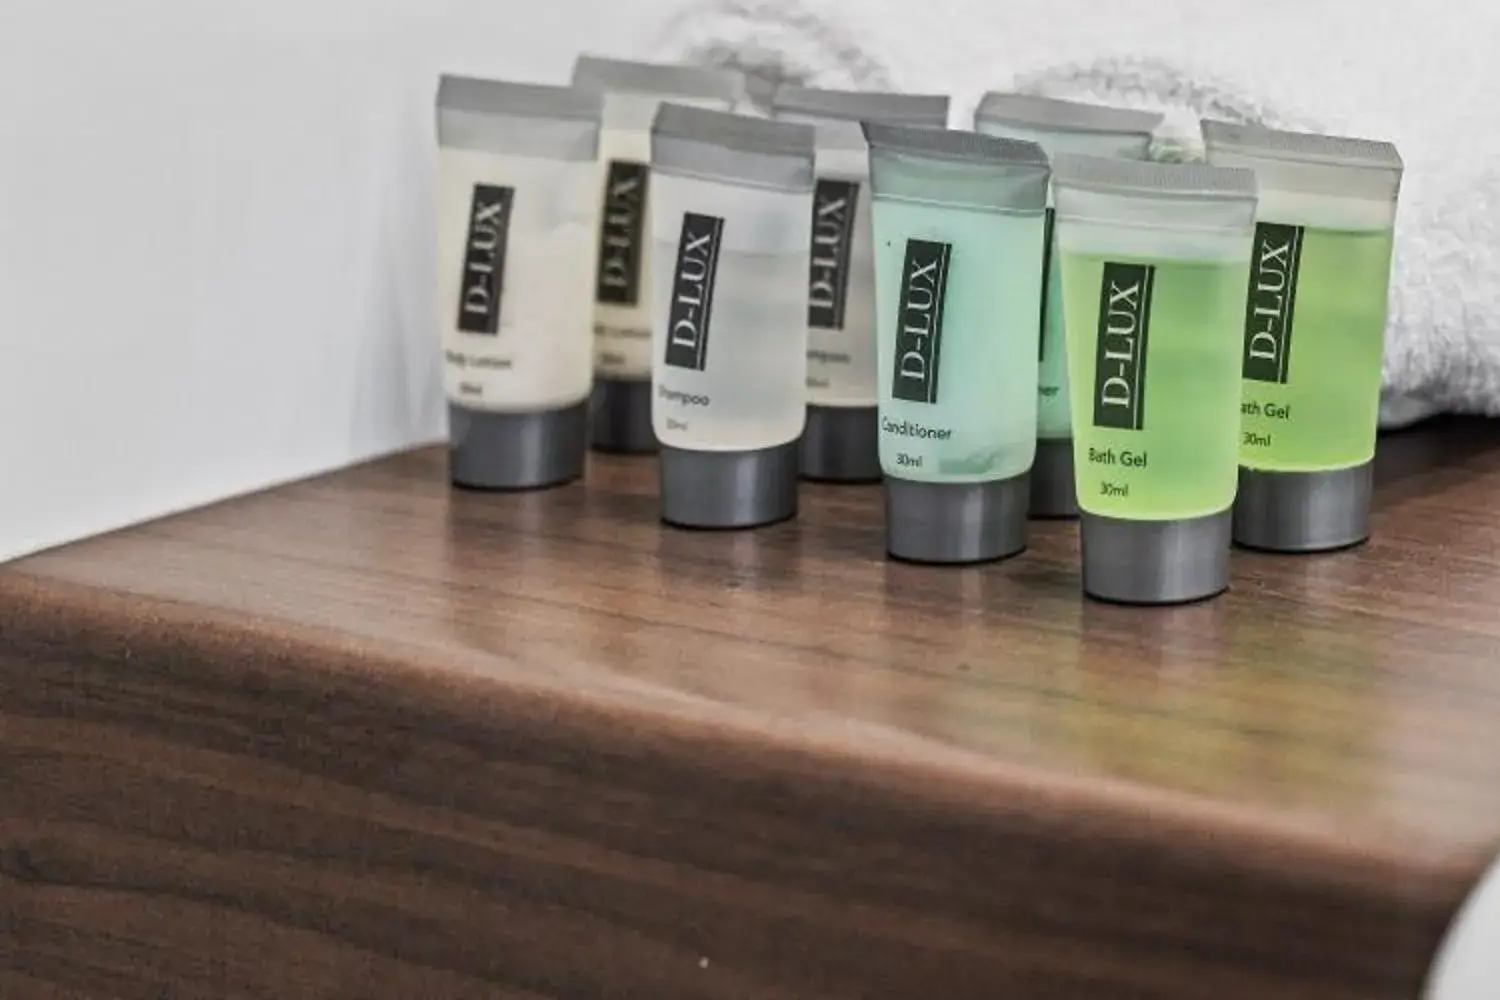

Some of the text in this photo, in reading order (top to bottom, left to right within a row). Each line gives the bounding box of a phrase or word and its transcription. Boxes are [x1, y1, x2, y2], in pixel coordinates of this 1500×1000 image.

[464, 201, 502, 314] D-LUX
[672, 230, 712, 348] D-LUX
[808, 195, 847, 309] D-LUX
[1250, 238, 1291, 363] D-LUX
[901, 259, 939, 383] D-LUX
[1101, 279, 1141, 410] D-LUX
[883, 415, 952, 440] Conditioner
[896, 453, 923, 468] 30ml
[1088, 447, 1147, 469] Bath Gel
[1241, 401, 1291, 420] ath Gel
